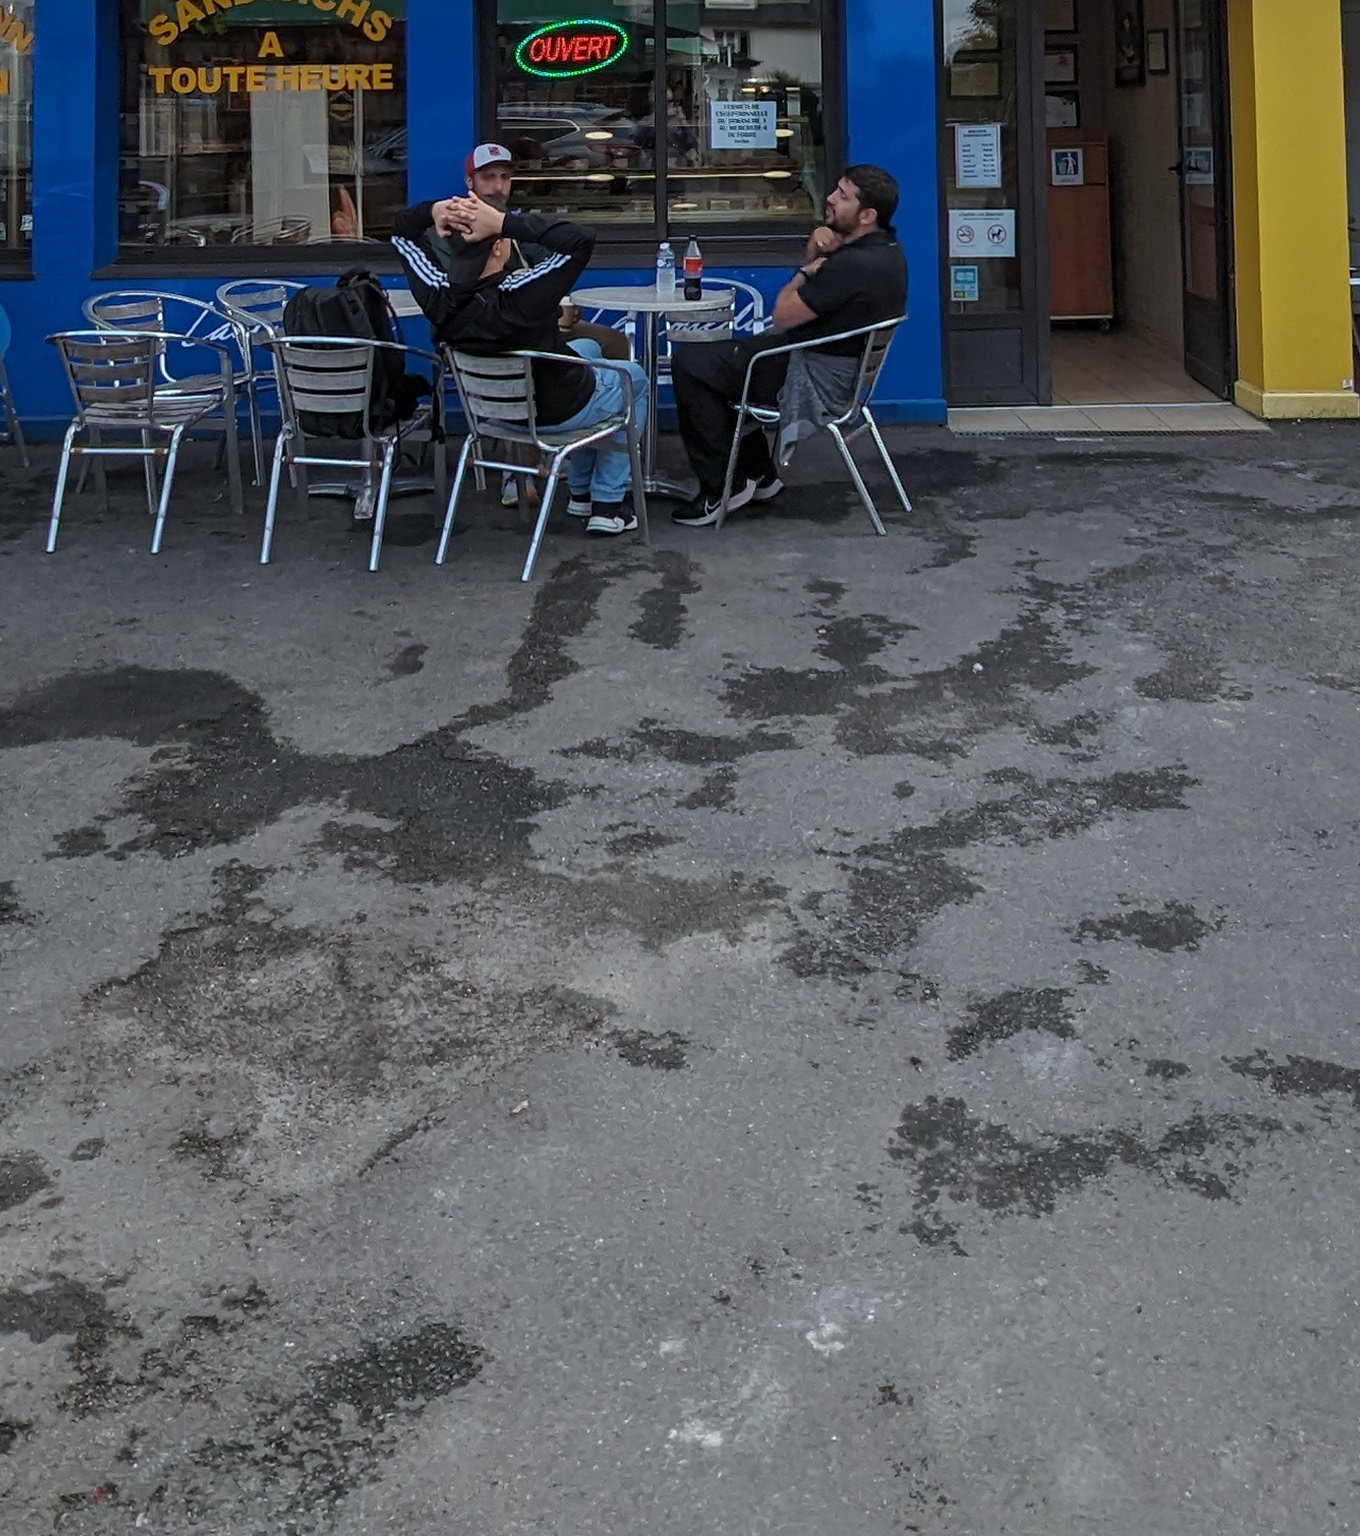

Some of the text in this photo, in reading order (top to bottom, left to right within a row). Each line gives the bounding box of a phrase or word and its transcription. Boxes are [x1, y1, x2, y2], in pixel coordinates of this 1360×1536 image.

[258, 31, 283, 58] A
[528, 34, 616, 63] OUVERT
[149, 63, 394, 95] TOUTE HEURE
